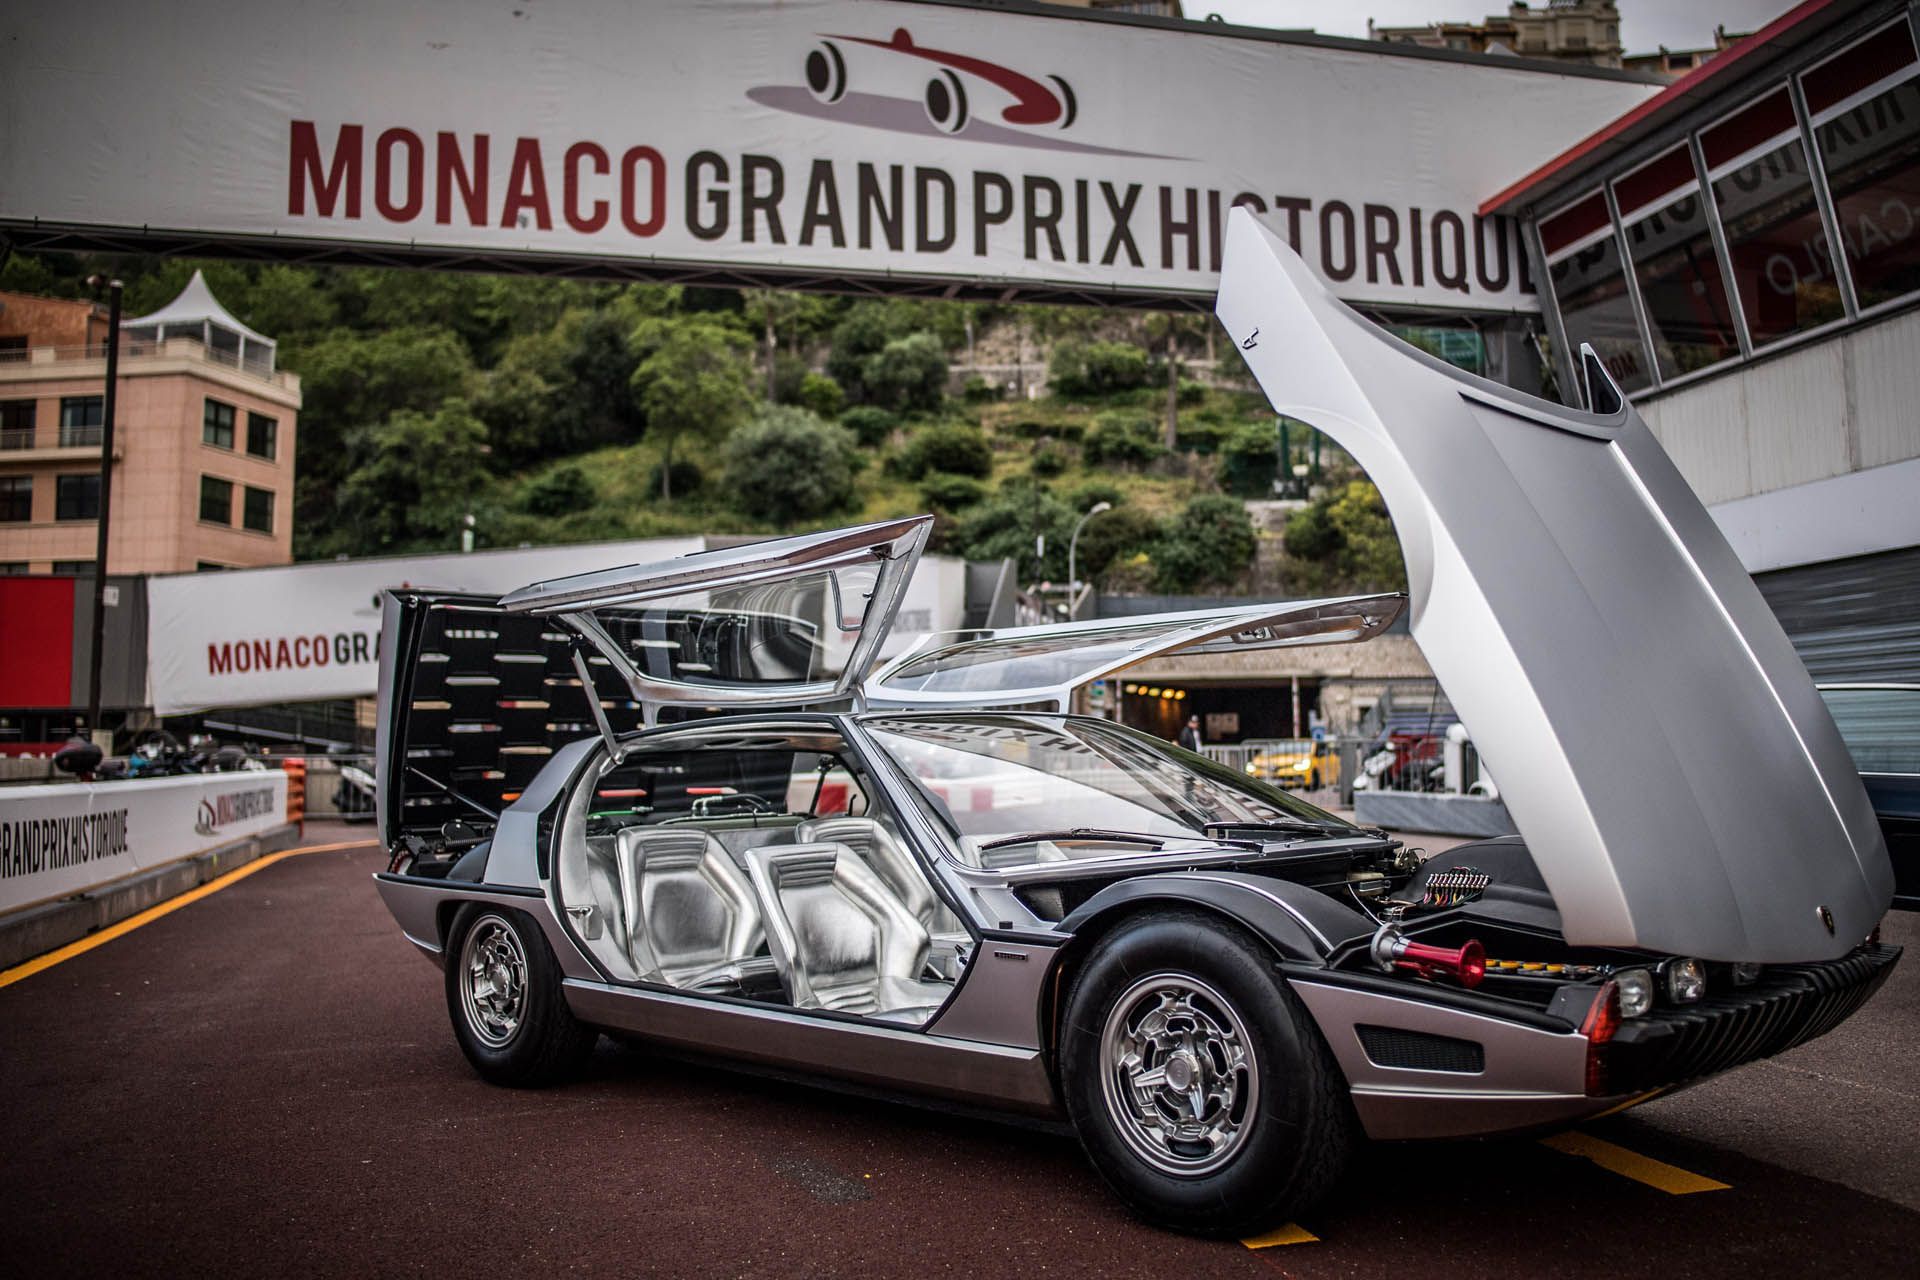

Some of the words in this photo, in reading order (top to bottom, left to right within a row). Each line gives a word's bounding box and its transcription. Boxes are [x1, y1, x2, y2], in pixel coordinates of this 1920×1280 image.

[287, 119, 667, 239] MONACO
[684, 150, 956, 253] GRAND
[973, 170, 1145, 268] PRIX
[1159, 185, 1538, 295] HITORIQU
[207, 634, 330, 676] MONACO
[0, 820, 40, 879] RAND
[41, 817, 70, 873] PRIX
[71, 808, 128, 866] HISTORIQUE
